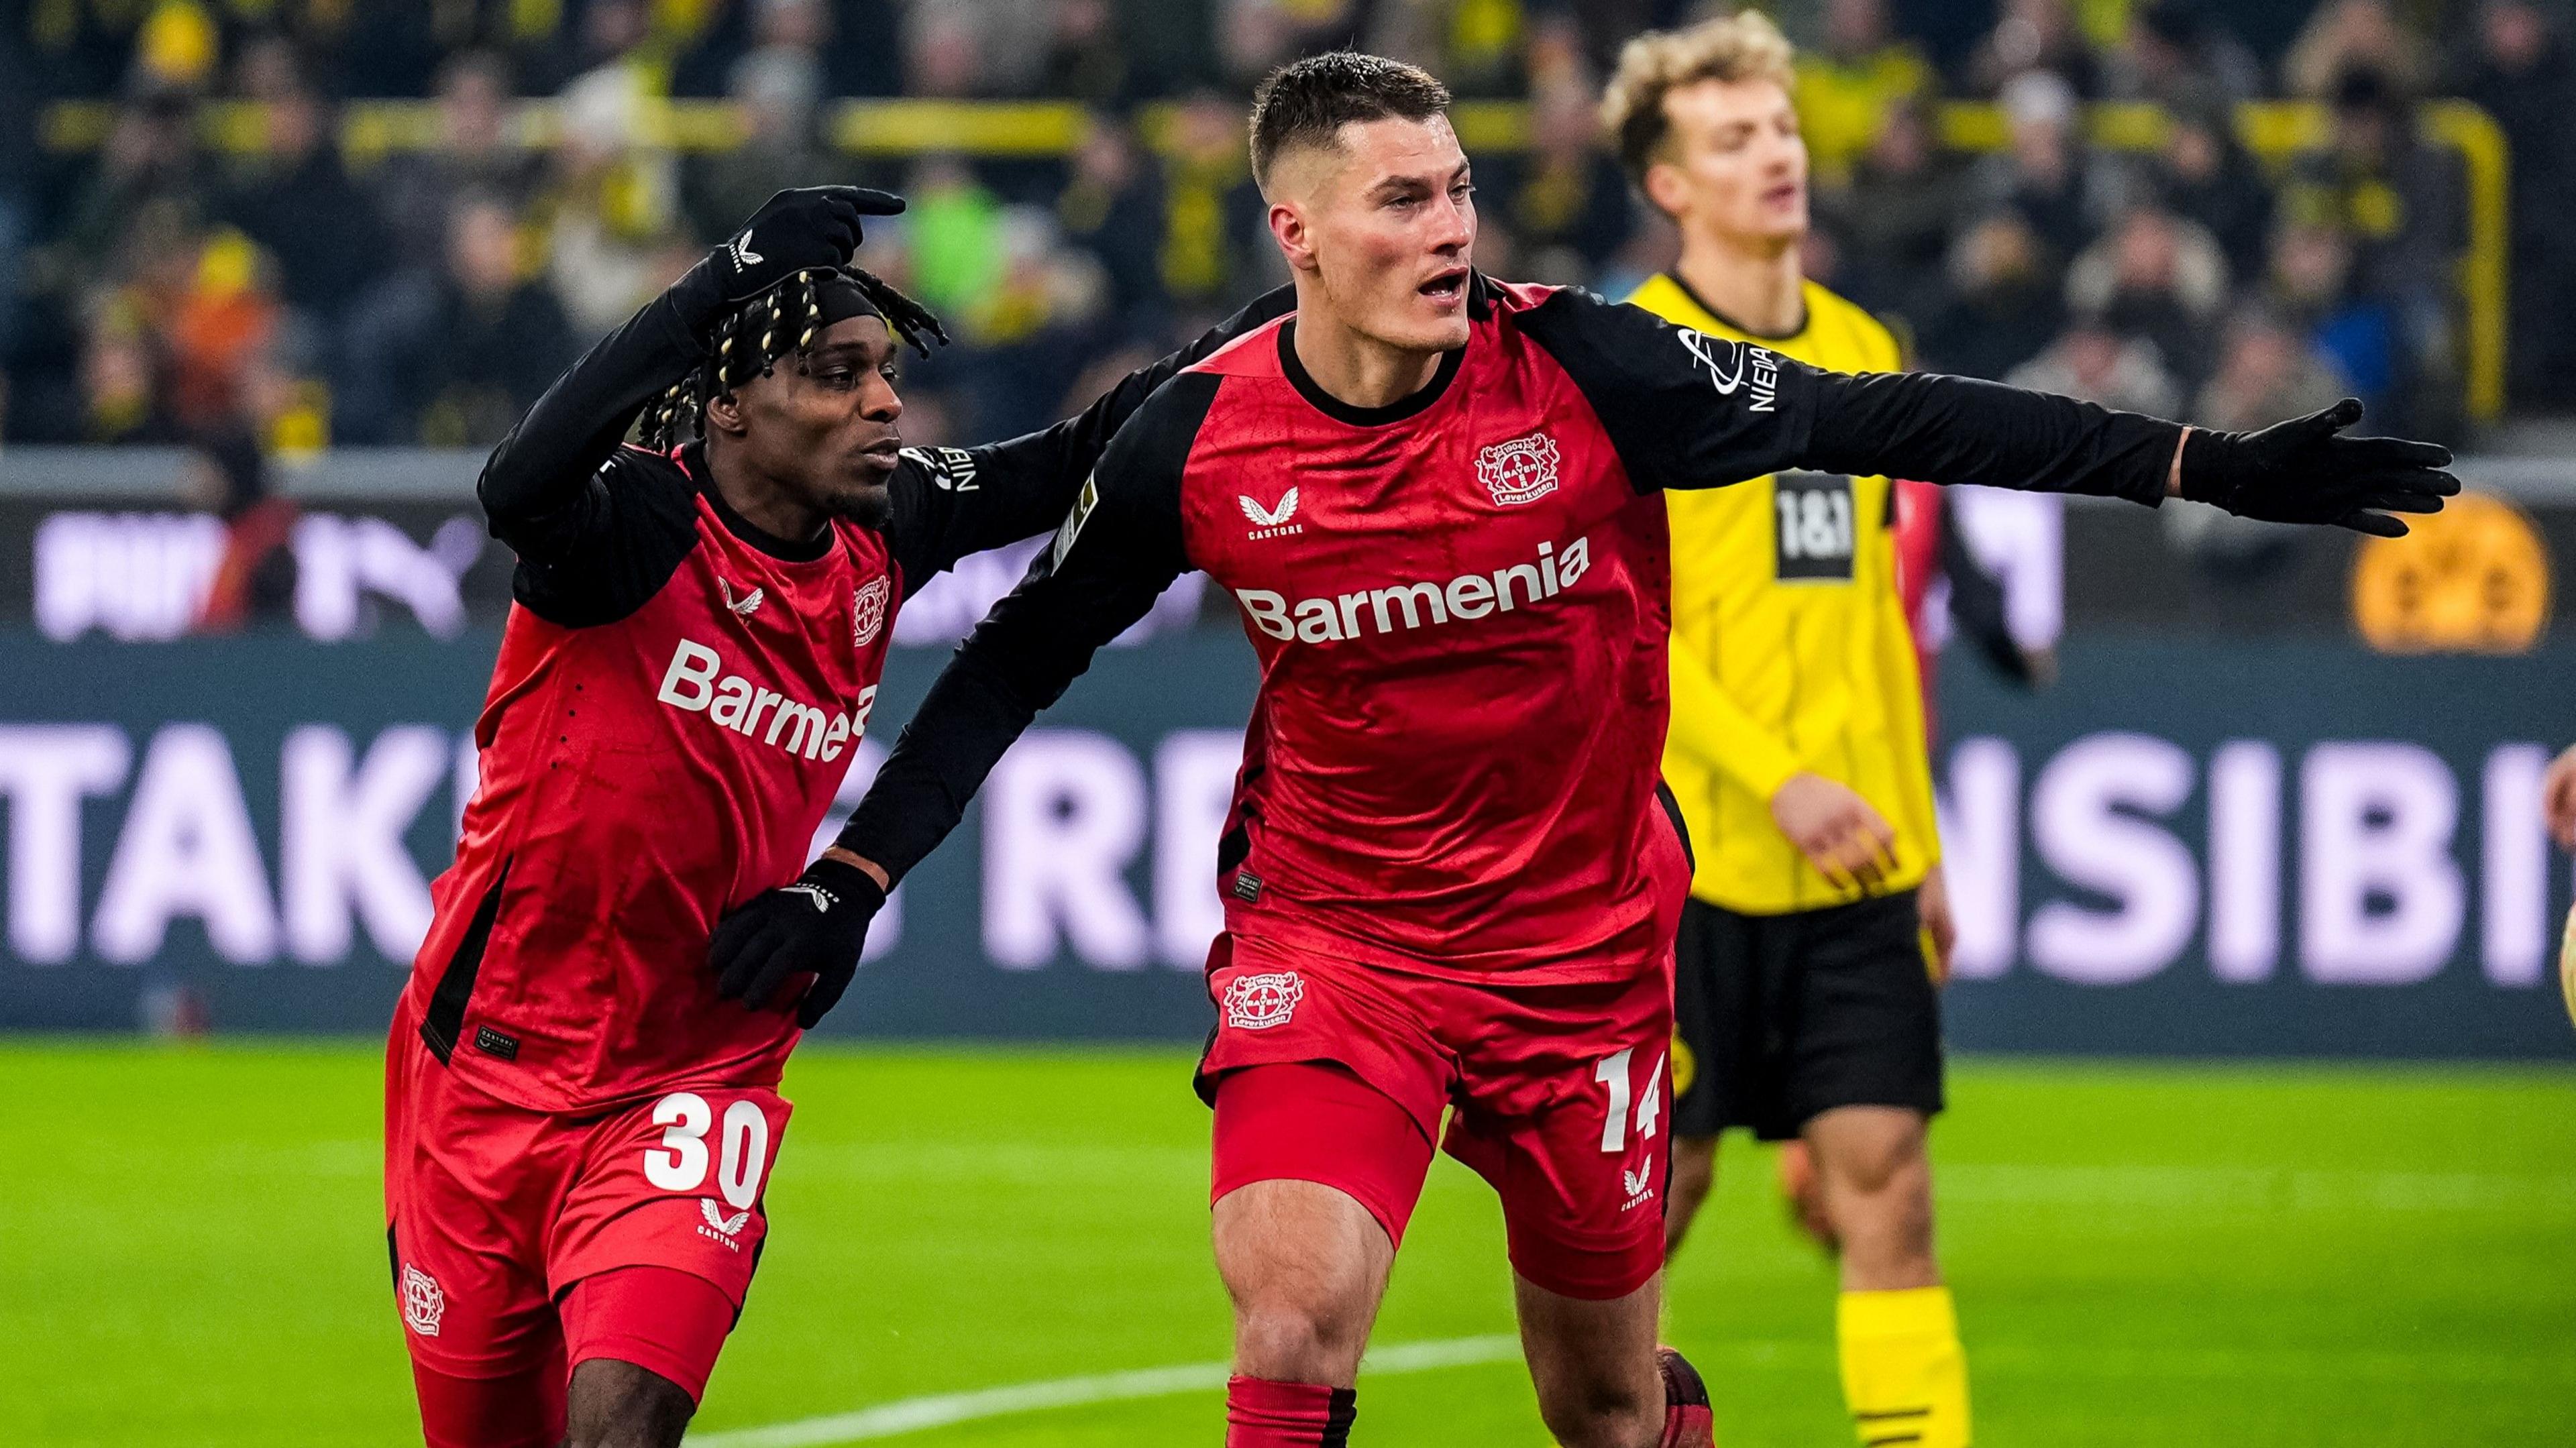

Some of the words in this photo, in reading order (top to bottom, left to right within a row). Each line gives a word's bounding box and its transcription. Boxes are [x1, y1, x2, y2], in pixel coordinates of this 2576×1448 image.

[1498, 482, 1553, 502] Leverkusen
[1503, 463, 1537, 479] BAYER
[1248, 524, 1303, 541] CASTORE
[1236, 537, 1591, 644] Barmenia
[657, 638, 878, 763] Barmea
[0, 722, 480, 966] TAK
[643, 1091, 769, 1211] 30
[1595, 1047, 1665, 1152] 14
